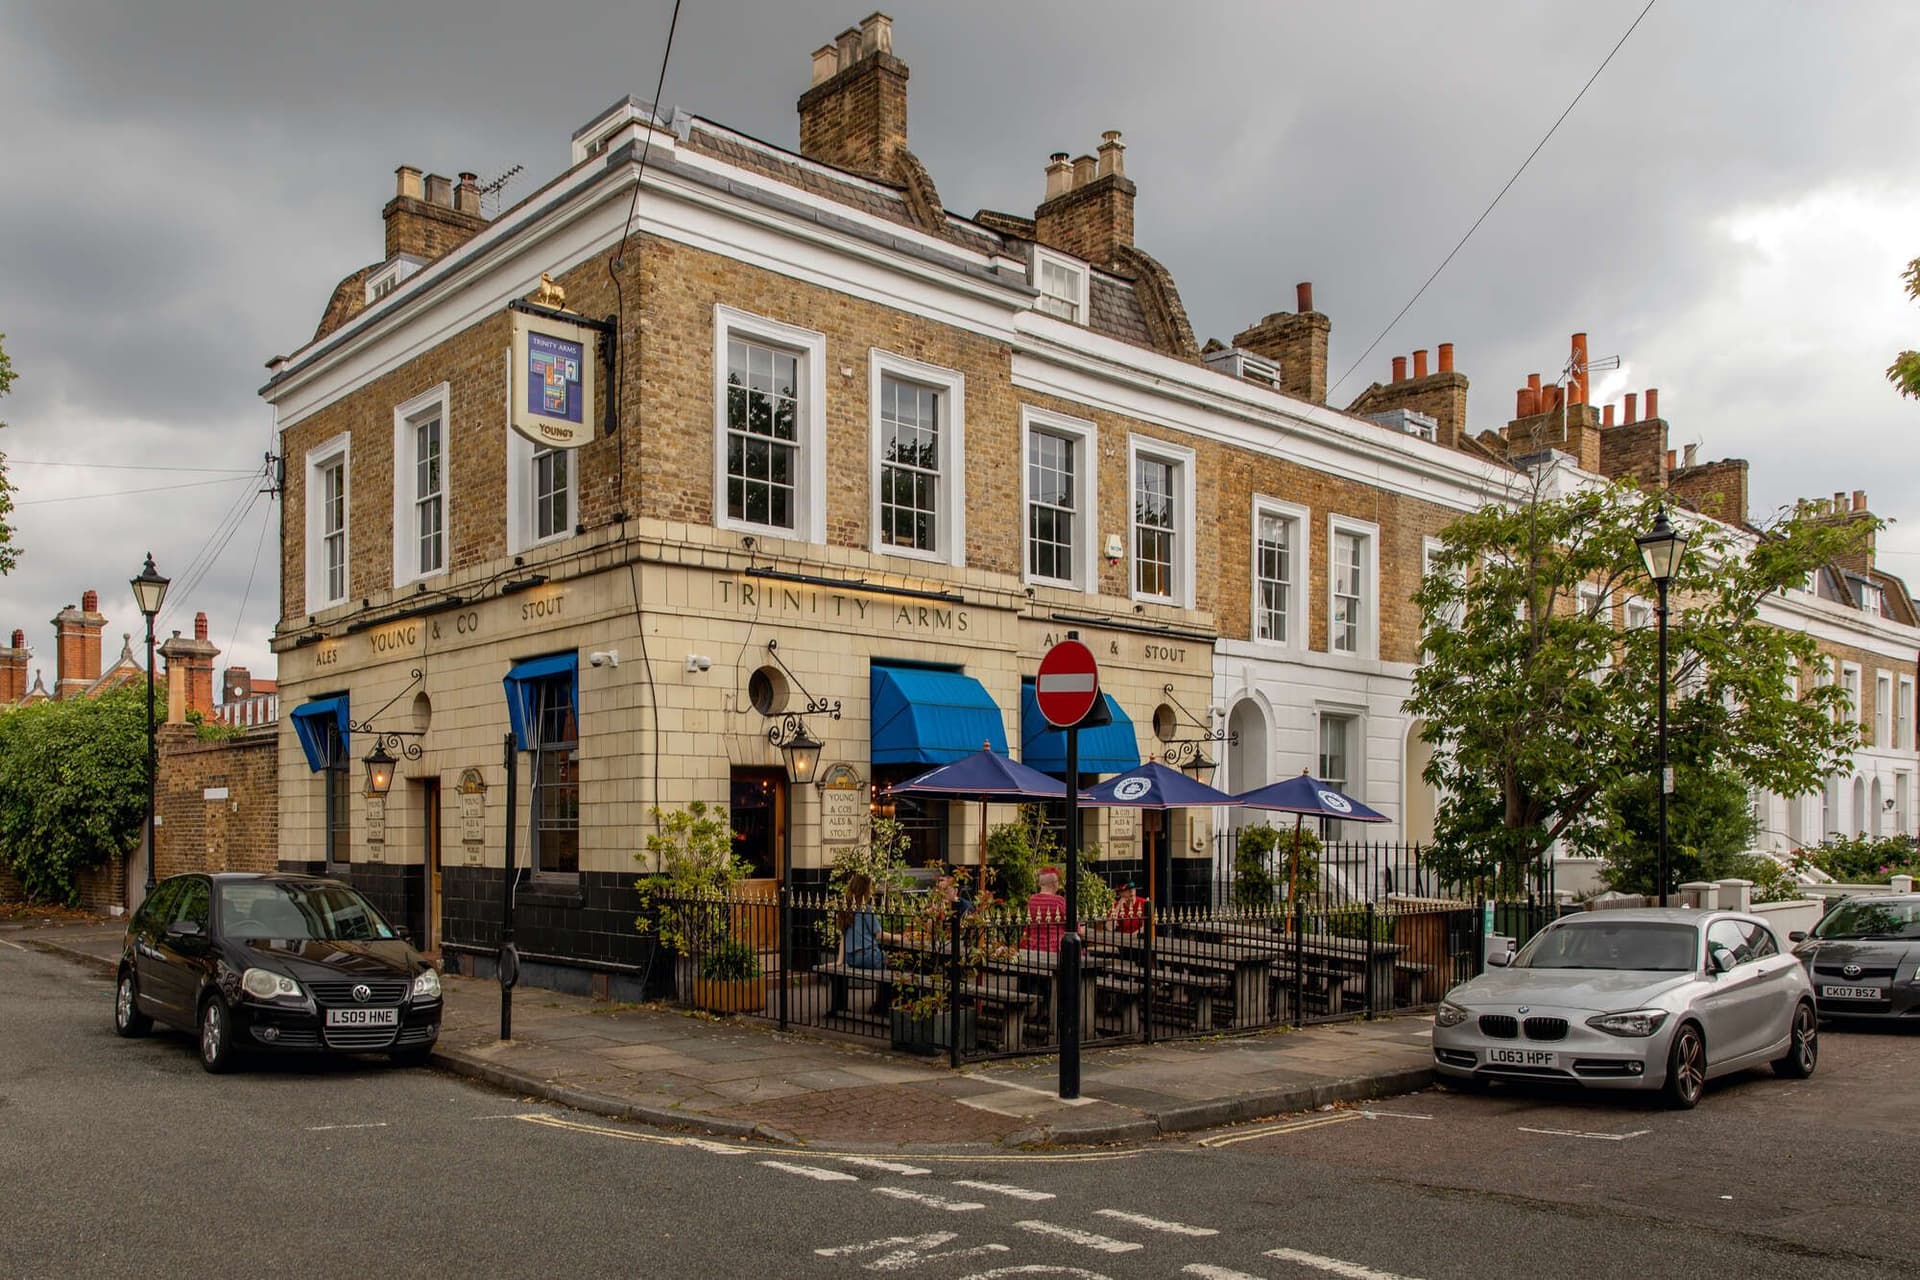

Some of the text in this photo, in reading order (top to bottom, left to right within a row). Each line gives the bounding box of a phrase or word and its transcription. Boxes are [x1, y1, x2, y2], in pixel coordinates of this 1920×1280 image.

[533, 338, 577, 354] TRINITY ARMS
[522, 596, 564, 621] STOUT
[718, 579, 968, 631] TRINITY ARMS
[369, 611, 479, 654] YOUNG & CO
[316, 649, 337, 666] ALES
[1110, 641, 1119, 655] &
[1145, 644, 1186, 663] STOUT
[829, 793, 854, 802] YOUNG
[829, 817, 846, 826] ALES
[830, 830, 852, 838] STOUT
[1826, 987, 1853, 997] CK07
[332, 1010, 393, 1023] LS09 HNE
[1490, 1049, 1553, 1065] LO63 HPF
